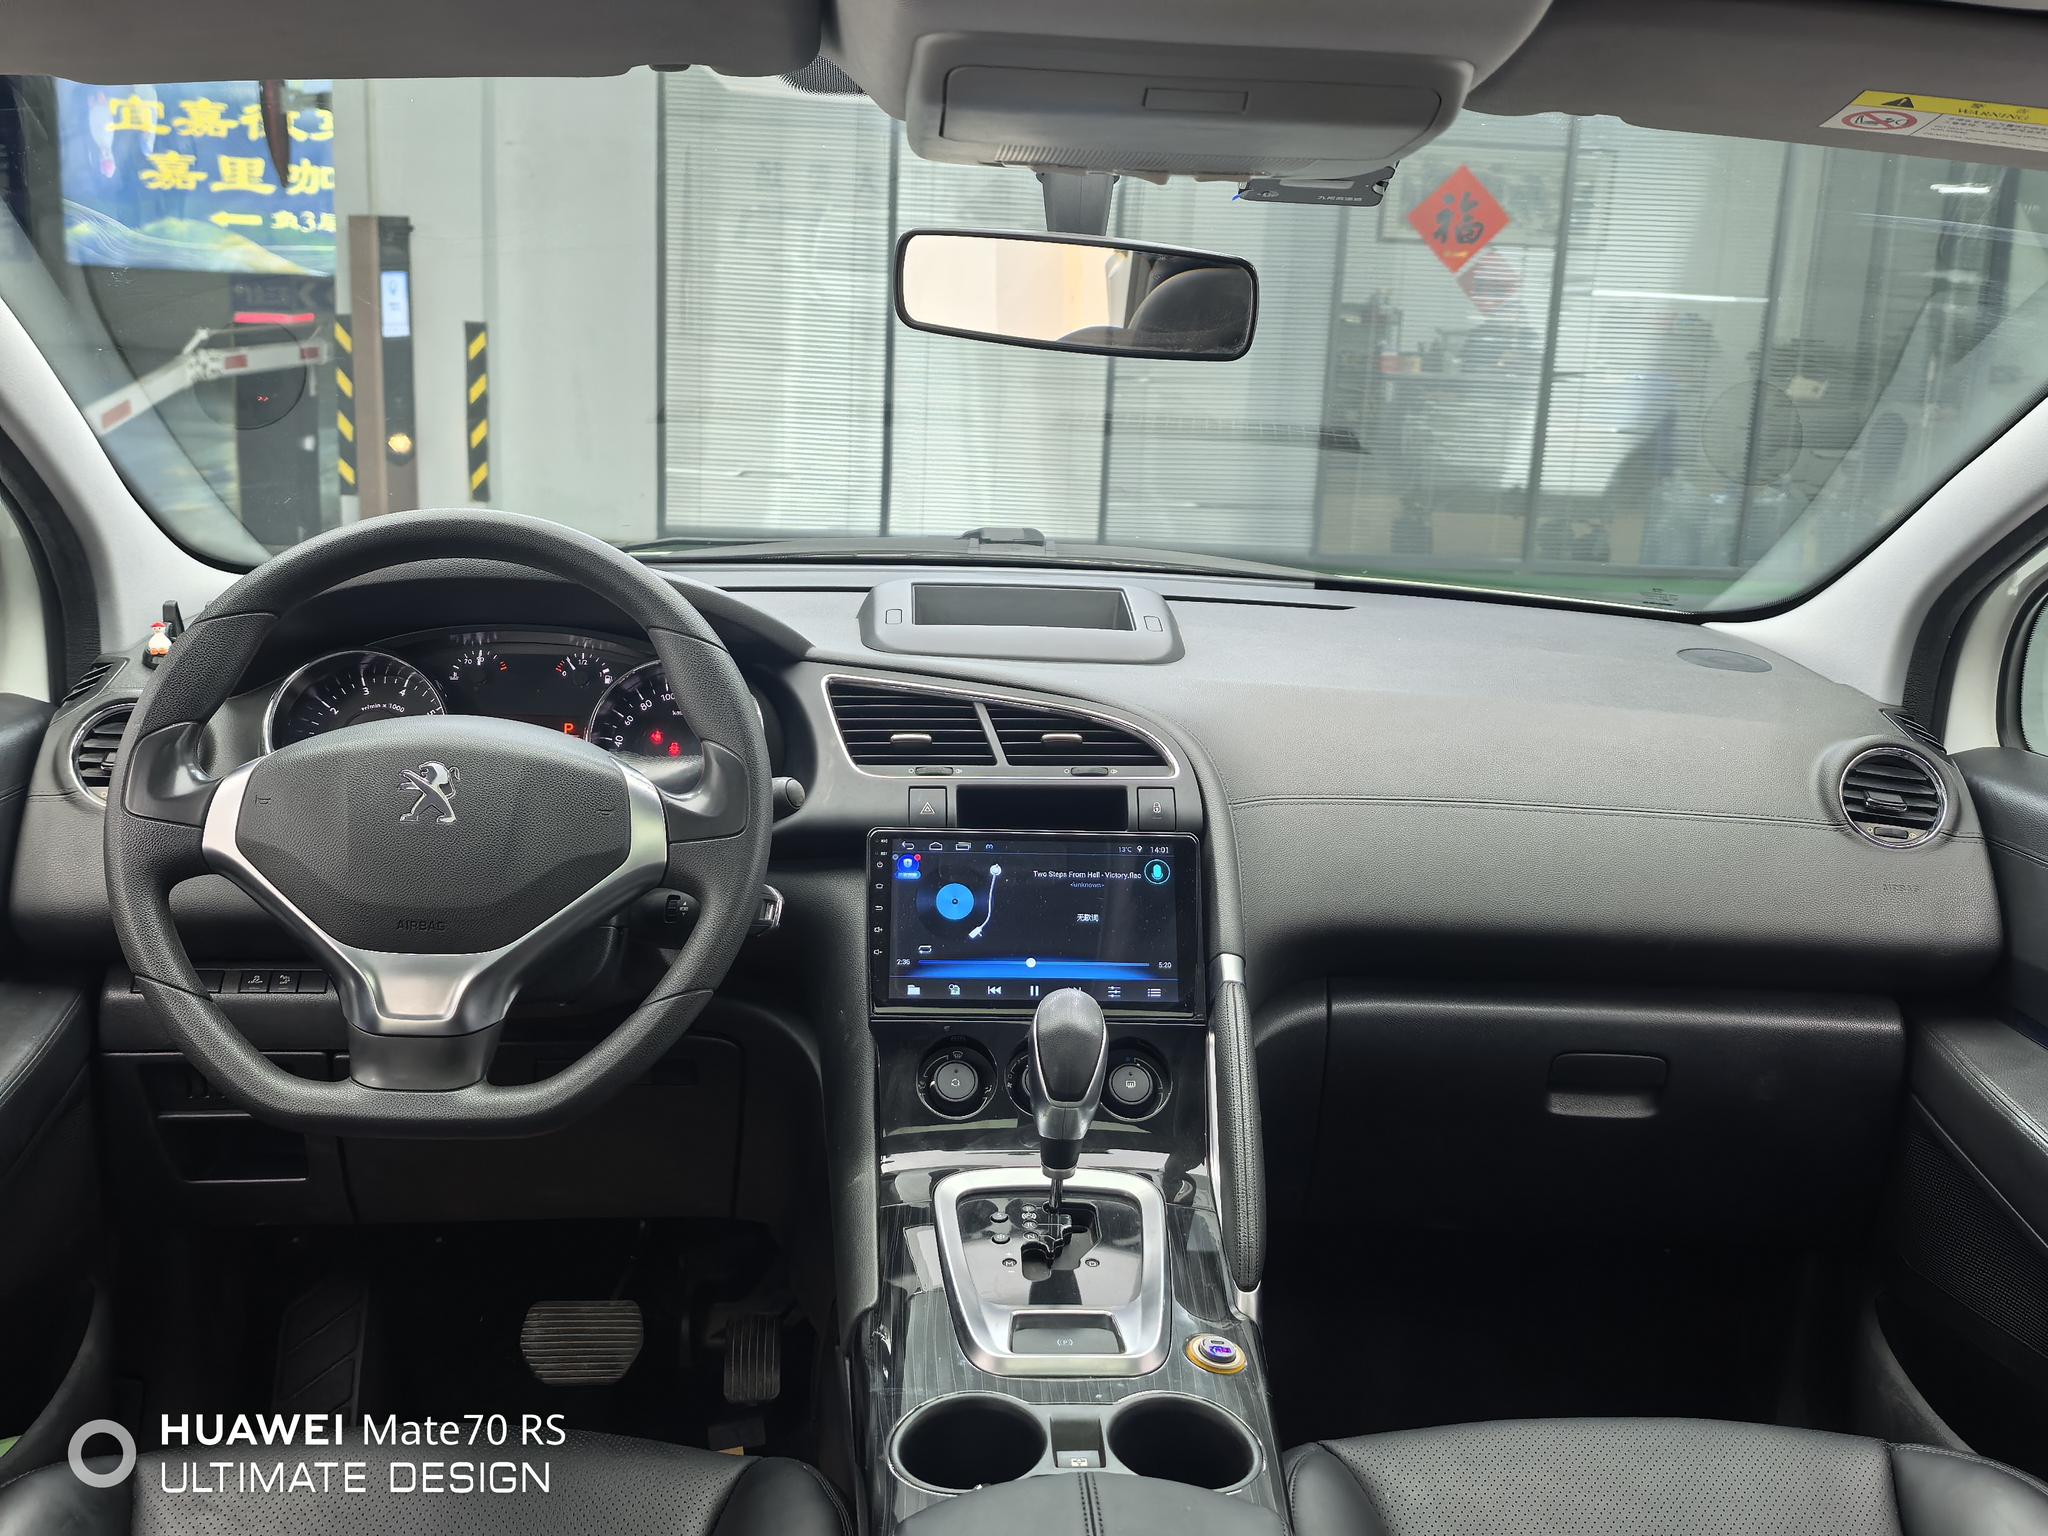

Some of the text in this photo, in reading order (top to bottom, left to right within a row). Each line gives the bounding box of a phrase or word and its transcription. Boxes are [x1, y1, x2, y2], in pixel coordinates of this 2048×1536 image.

[1432, 191, 1485, 245] 福
[329, 706, 340, 716] 2
[363, 687, 370, 696] 3
[399, 687, 406, 697] 4
[388, 703, 405, 713] 1000
[564, 722, 574, 734] P
[614, 735, 624, 748] 40
[624, 715, 634, 726] 60
[640, 699, 653, 711] 80
[1150, 846, 1169, 854] 14:01
[1033, 870, 1048, 879] Two
[1048, 870, 1068, 880] Steps
[1068, 871, 1086, 879] From
[1087, 871, 1101, 879] Hell
[396, 919, 446, 932] AIRBAG
[1158, 961, 1172, 969] 5:20
